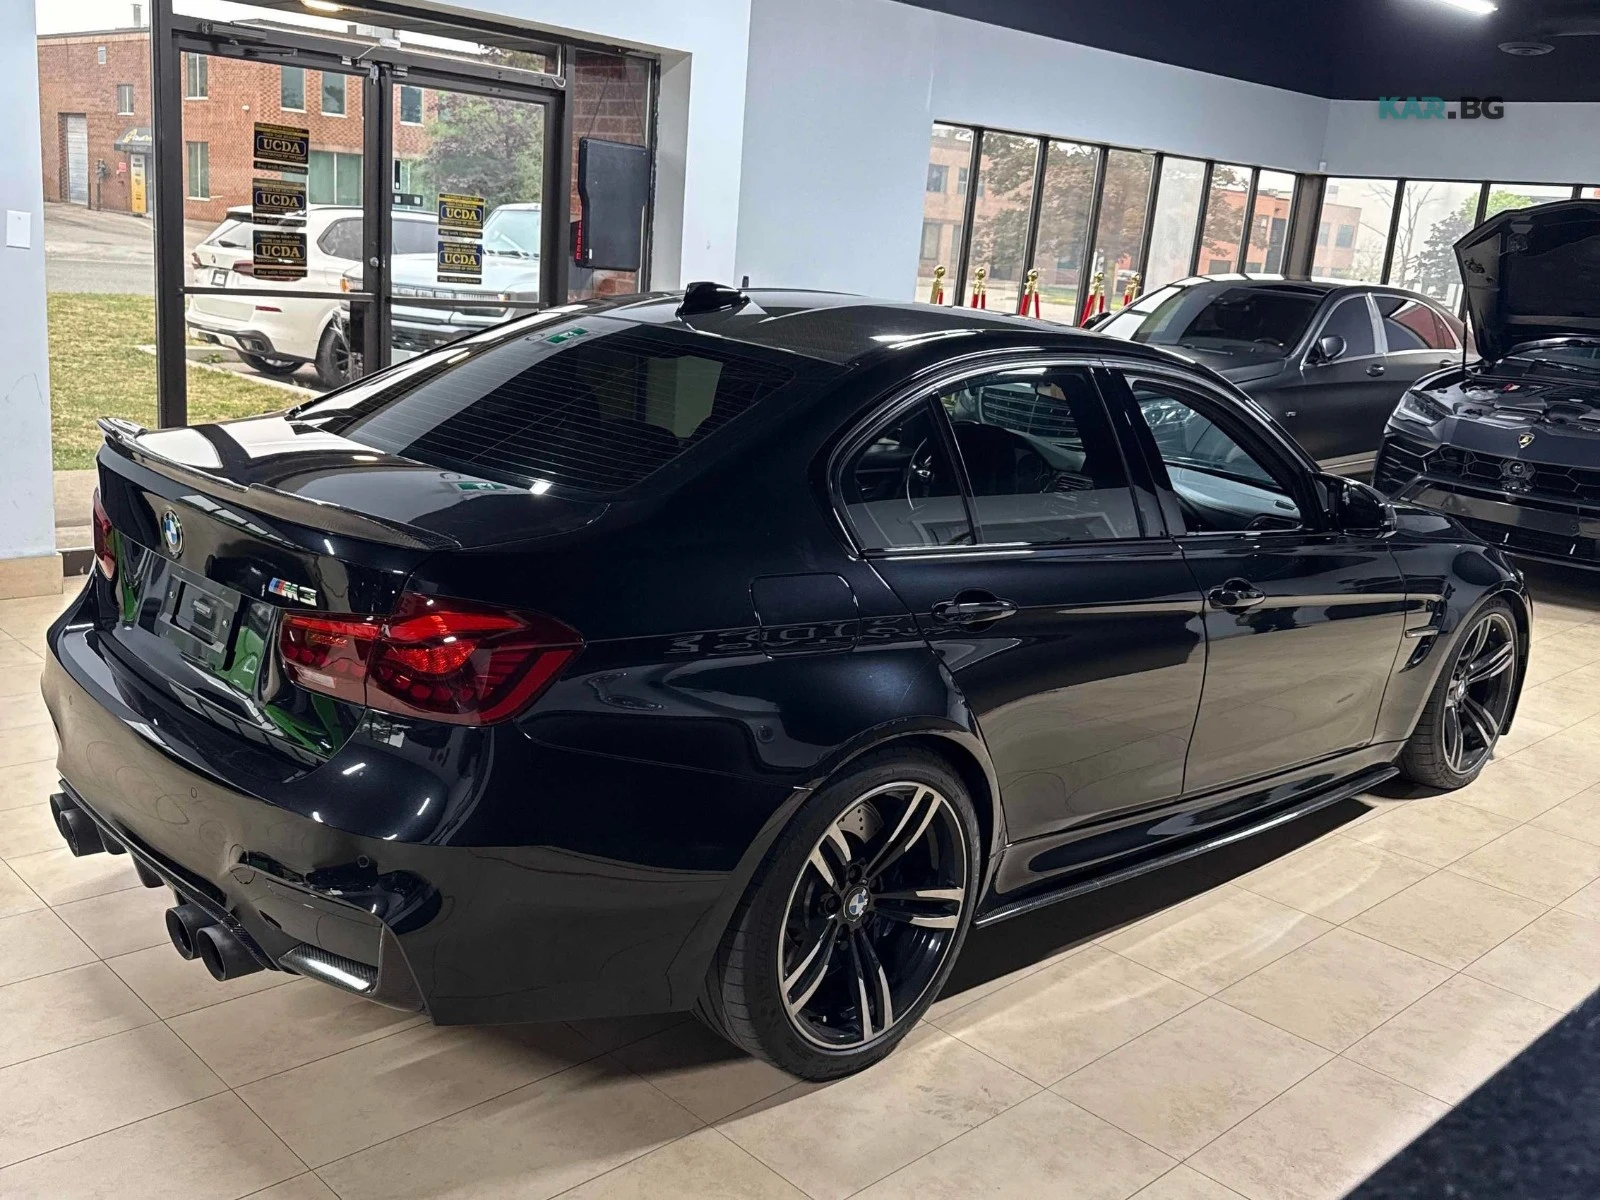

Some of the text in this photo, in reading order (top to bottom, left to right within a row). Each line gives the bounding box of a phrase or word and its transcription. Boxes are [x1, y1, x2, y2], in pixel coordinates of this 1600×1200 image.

[263, 138, 301, 154] UCDA
[261, 193, 300, 207] UCDA
[445, 207, 477, 220] UCDA
[261, 245, 301, 258] UCDA
[444, 253, 476, 265] UCDA
